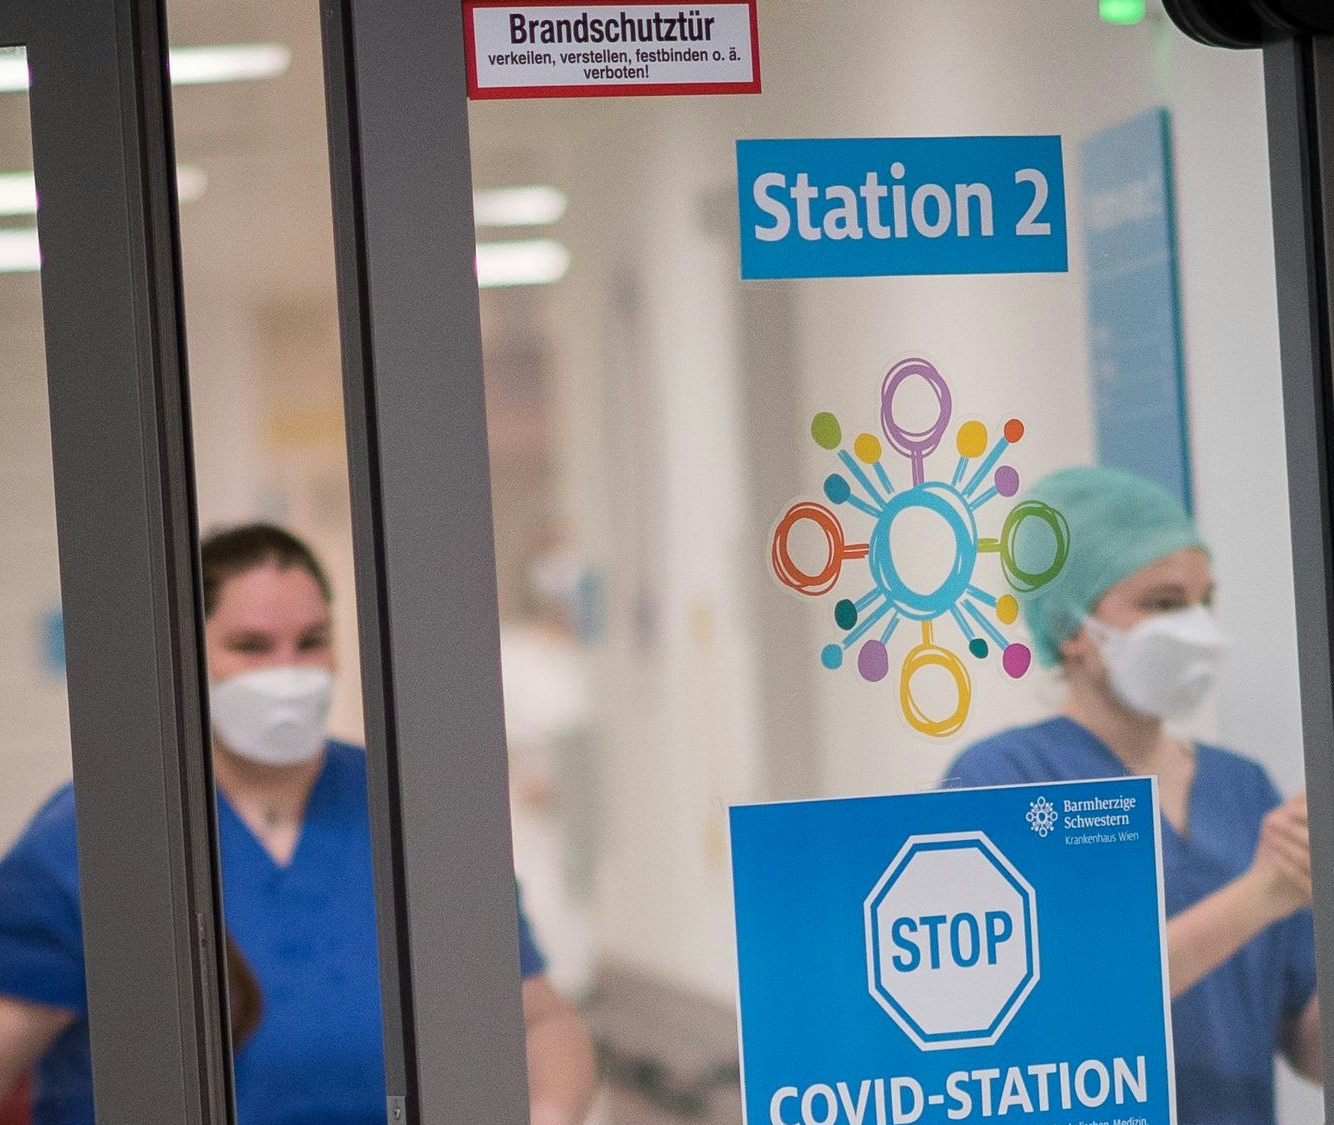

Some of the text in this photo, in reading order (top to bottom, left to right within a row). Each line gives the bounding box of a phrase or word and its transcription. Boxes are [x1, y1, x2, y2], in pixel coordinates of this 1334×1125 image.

[509, 10, 715, 44] Brandschutztür
[488, 47, 741, 67] verkeilen, verstellen, festbinden o. ä.
[584, 65, 650, 80] verboten!
[753, 162, 994, 242] Station
[1015, 168, 1051, 236] 2
[1064, 795, 1136, 811] Barmherzige
[1064, 814, 1129, 829] Schwestern
[1065, 830, 1139, 845] Krankenhaus Wien
[891, 910, 1013, 973] STOP
